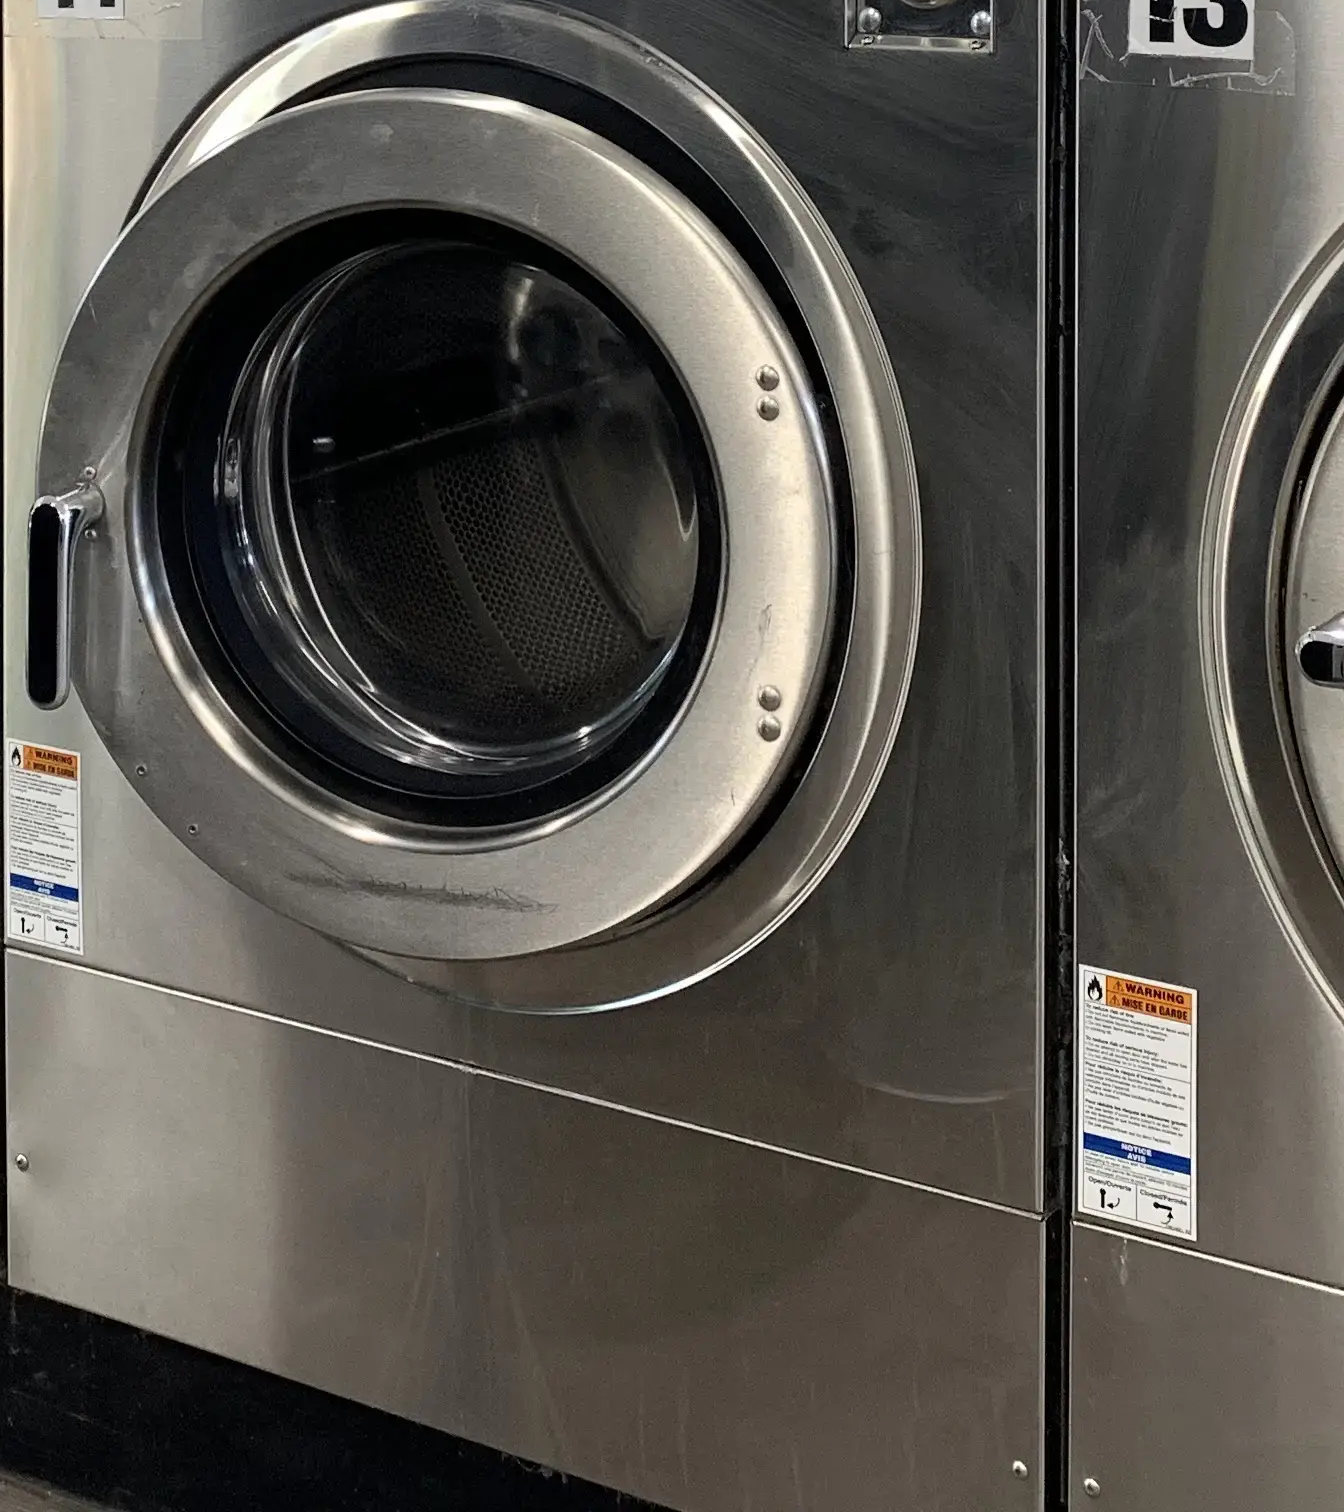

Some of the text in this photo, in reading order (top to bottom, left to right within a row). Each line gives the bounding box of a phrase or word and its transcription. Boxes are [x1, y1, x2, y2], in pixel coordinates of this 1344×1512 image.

[35, 750, 73, 765] WARNING
[1125, 983, 1184, 1004] WARNING
[1122, 997, 1188, 1021] MISE EN GARDE
[1121, 1143, 1152, 1157] NOTICE
